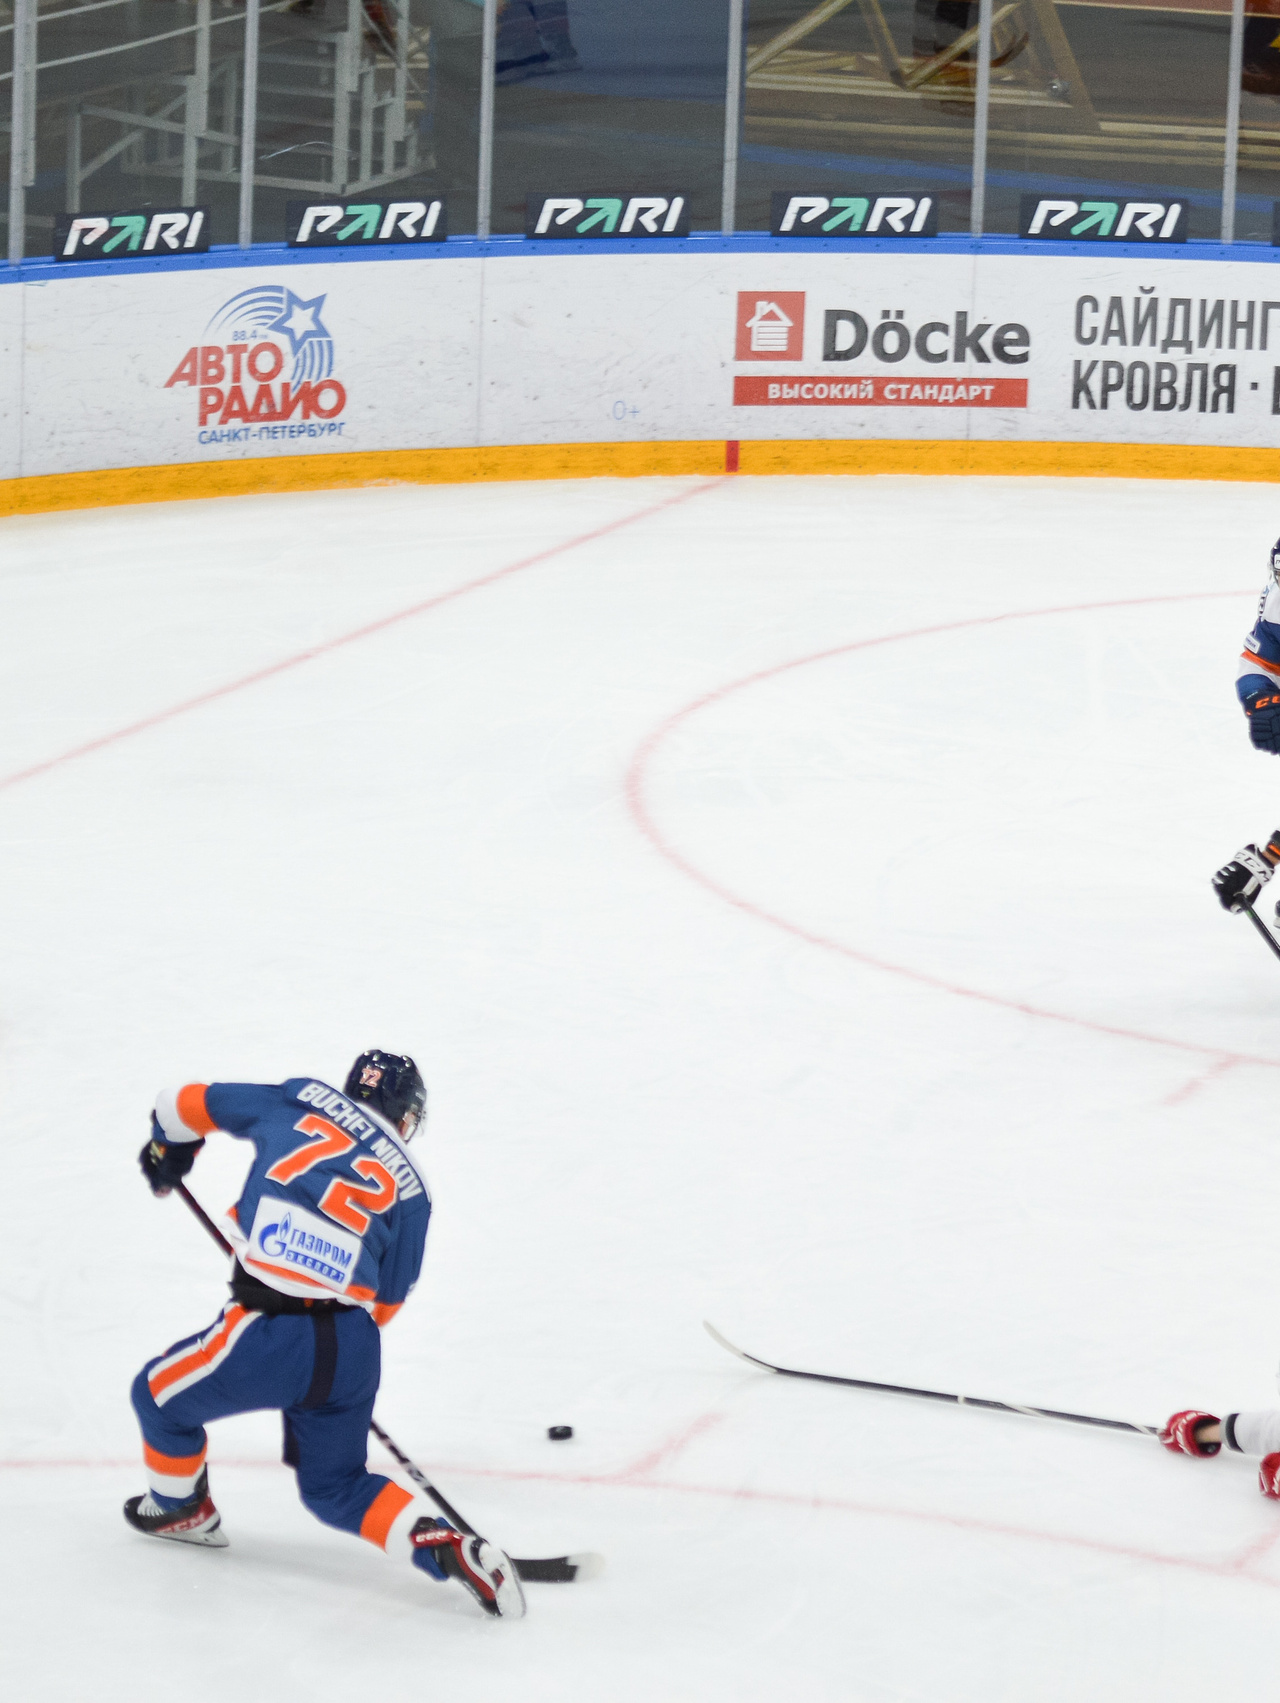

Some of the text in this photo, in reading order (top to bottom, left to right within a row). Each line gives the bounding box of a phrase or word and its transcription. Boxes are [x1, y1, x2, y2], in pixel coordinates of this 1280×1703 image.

[63, 211, 204, 255] PARI
[296, 200, 441, 242] PARI
[534, 197, 685, 234] PARI
[779, 196, 932, 232] PARI
[1027, 199, 1181, 239] PARI
[232, 330, 258, 341] 88.4
[822, 309, 1030, 365] Döcke
[163, 342, 283, 388] АВТО
[198, 379, 346, 427] РАДИО
[767, 380, 995, 404] ВЫСОКИЙ СТАНДАРТ
[1071, 359, 1237, 415] КРОВЛЯ
[612, 400, 640, 420] 0+
[198, 422, 346, 444] САНКТ-ПЕТЕРБУРГ
[361, 1067, 382, 1088] 72
[264, 1112, 398, 1238] 72
[286, 1251, 346, 1284] ЭКСПОРТ
[289, 1228, 353, 1269] ГАЗПРОМ
